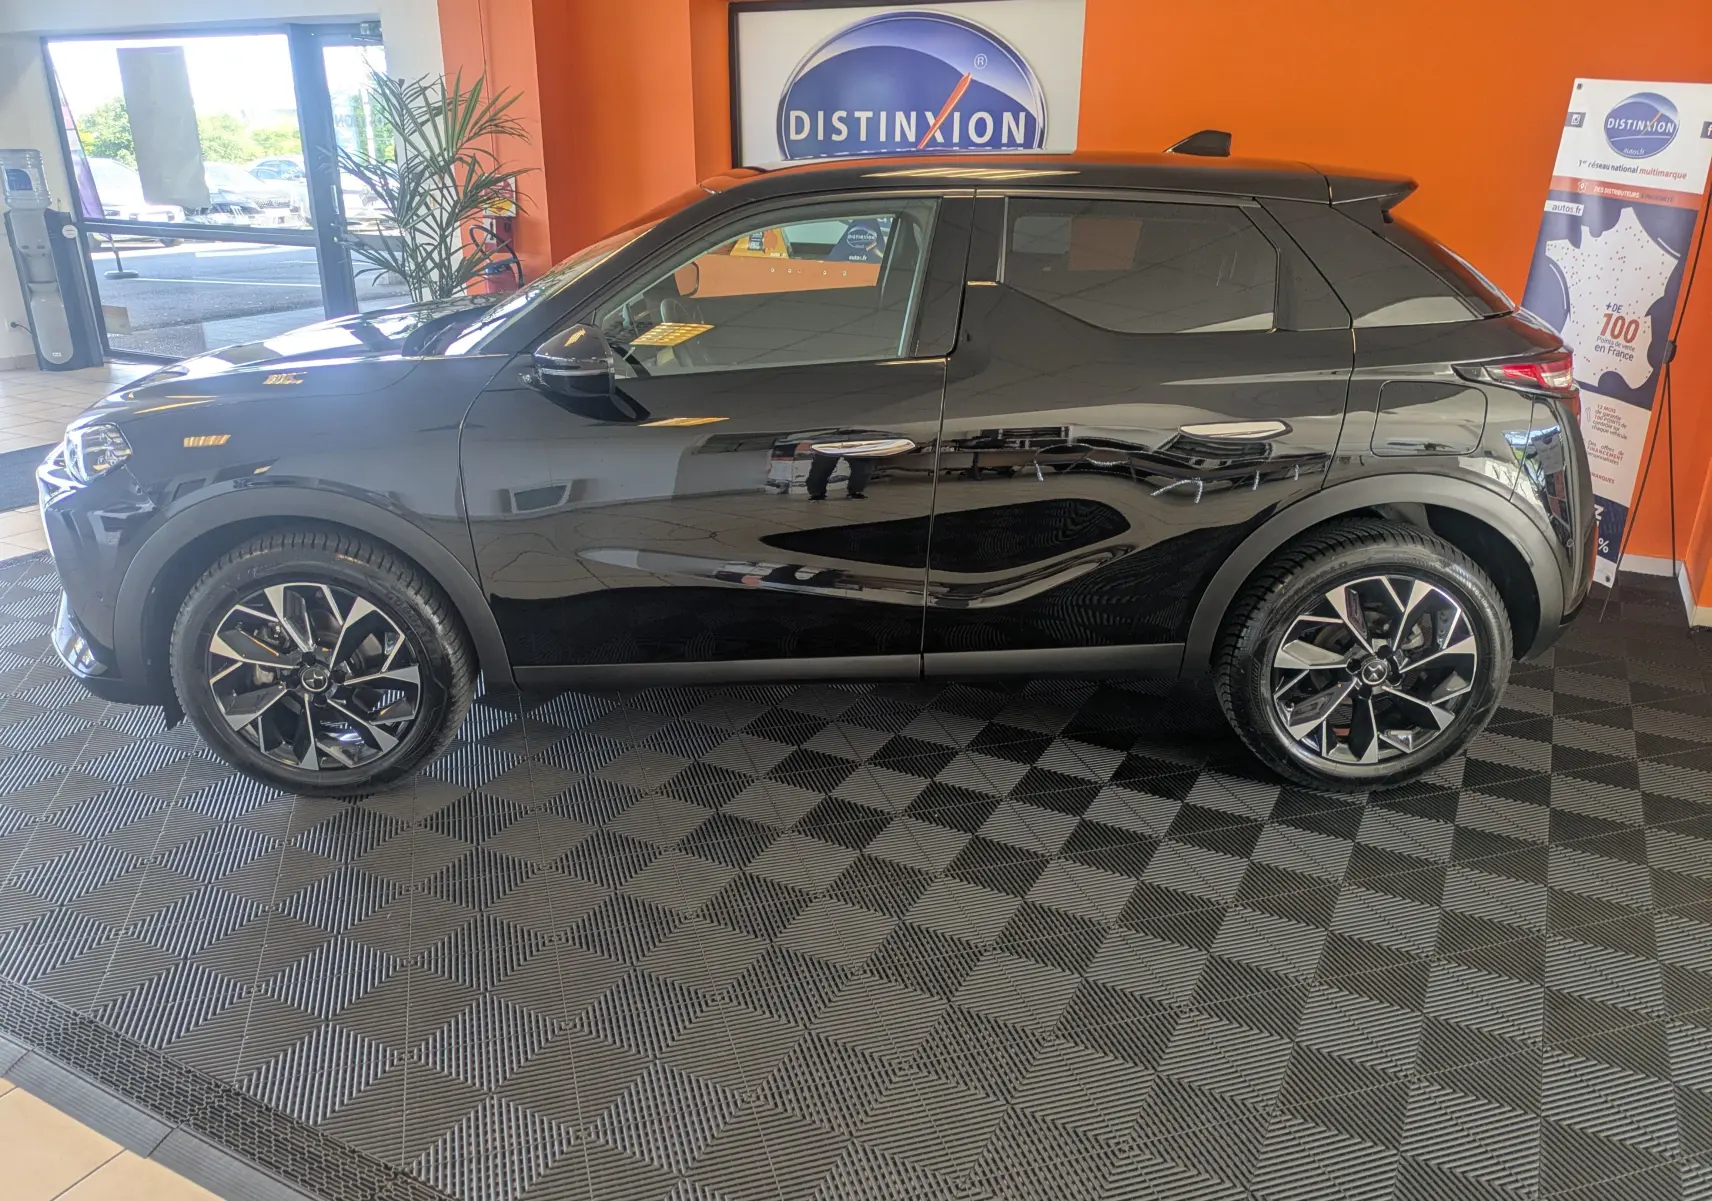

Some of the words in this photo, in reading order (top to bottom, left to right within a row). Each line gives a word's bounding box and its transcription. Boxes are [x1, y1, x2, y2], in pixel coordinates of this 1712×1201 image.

[789, 110, 1026, 145] DISTINXION
[1607, 118, 1675, 133] DISTINXION
[1588, 160, 1610, 171] réseau
[1611, 163, 1638, 174] national
[1639, 167, 1688, 180] multimarque
[1552, 204, 1582, 214] autos.fr
[1600, 313, 1640, 344] 100
[1594, 344, 1606, 353] en
[1607, 346, 1634, 361] France
[1597, 336, 1614, 346] Points
[1622, 343, 1636, 353] vente
[1588, 439, 1597, 447] Des
